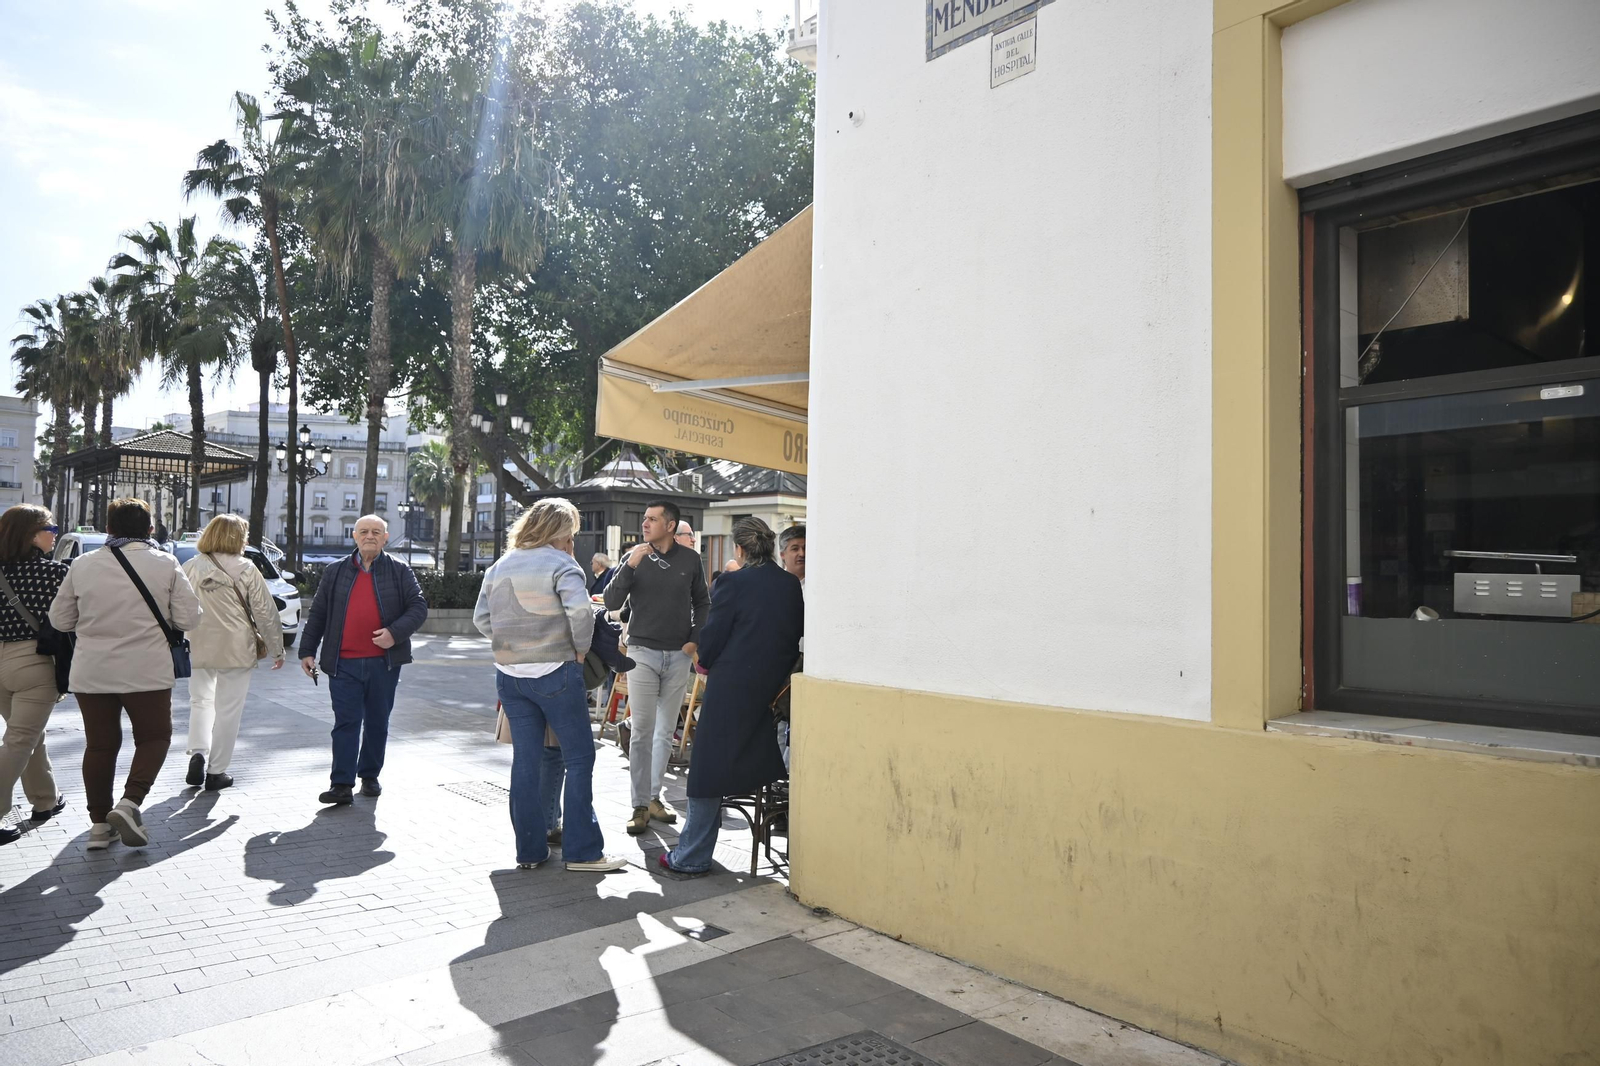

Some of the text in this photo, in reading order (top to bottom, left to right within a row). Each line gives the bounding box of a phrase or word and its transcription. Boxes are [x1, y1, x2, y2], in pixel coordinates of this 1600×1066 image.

[1017, 28, 1034, 43] CALLE
[1005, 47, 1020, 59] DEL
[994, 53, 1034, 79] HOSPITAL
